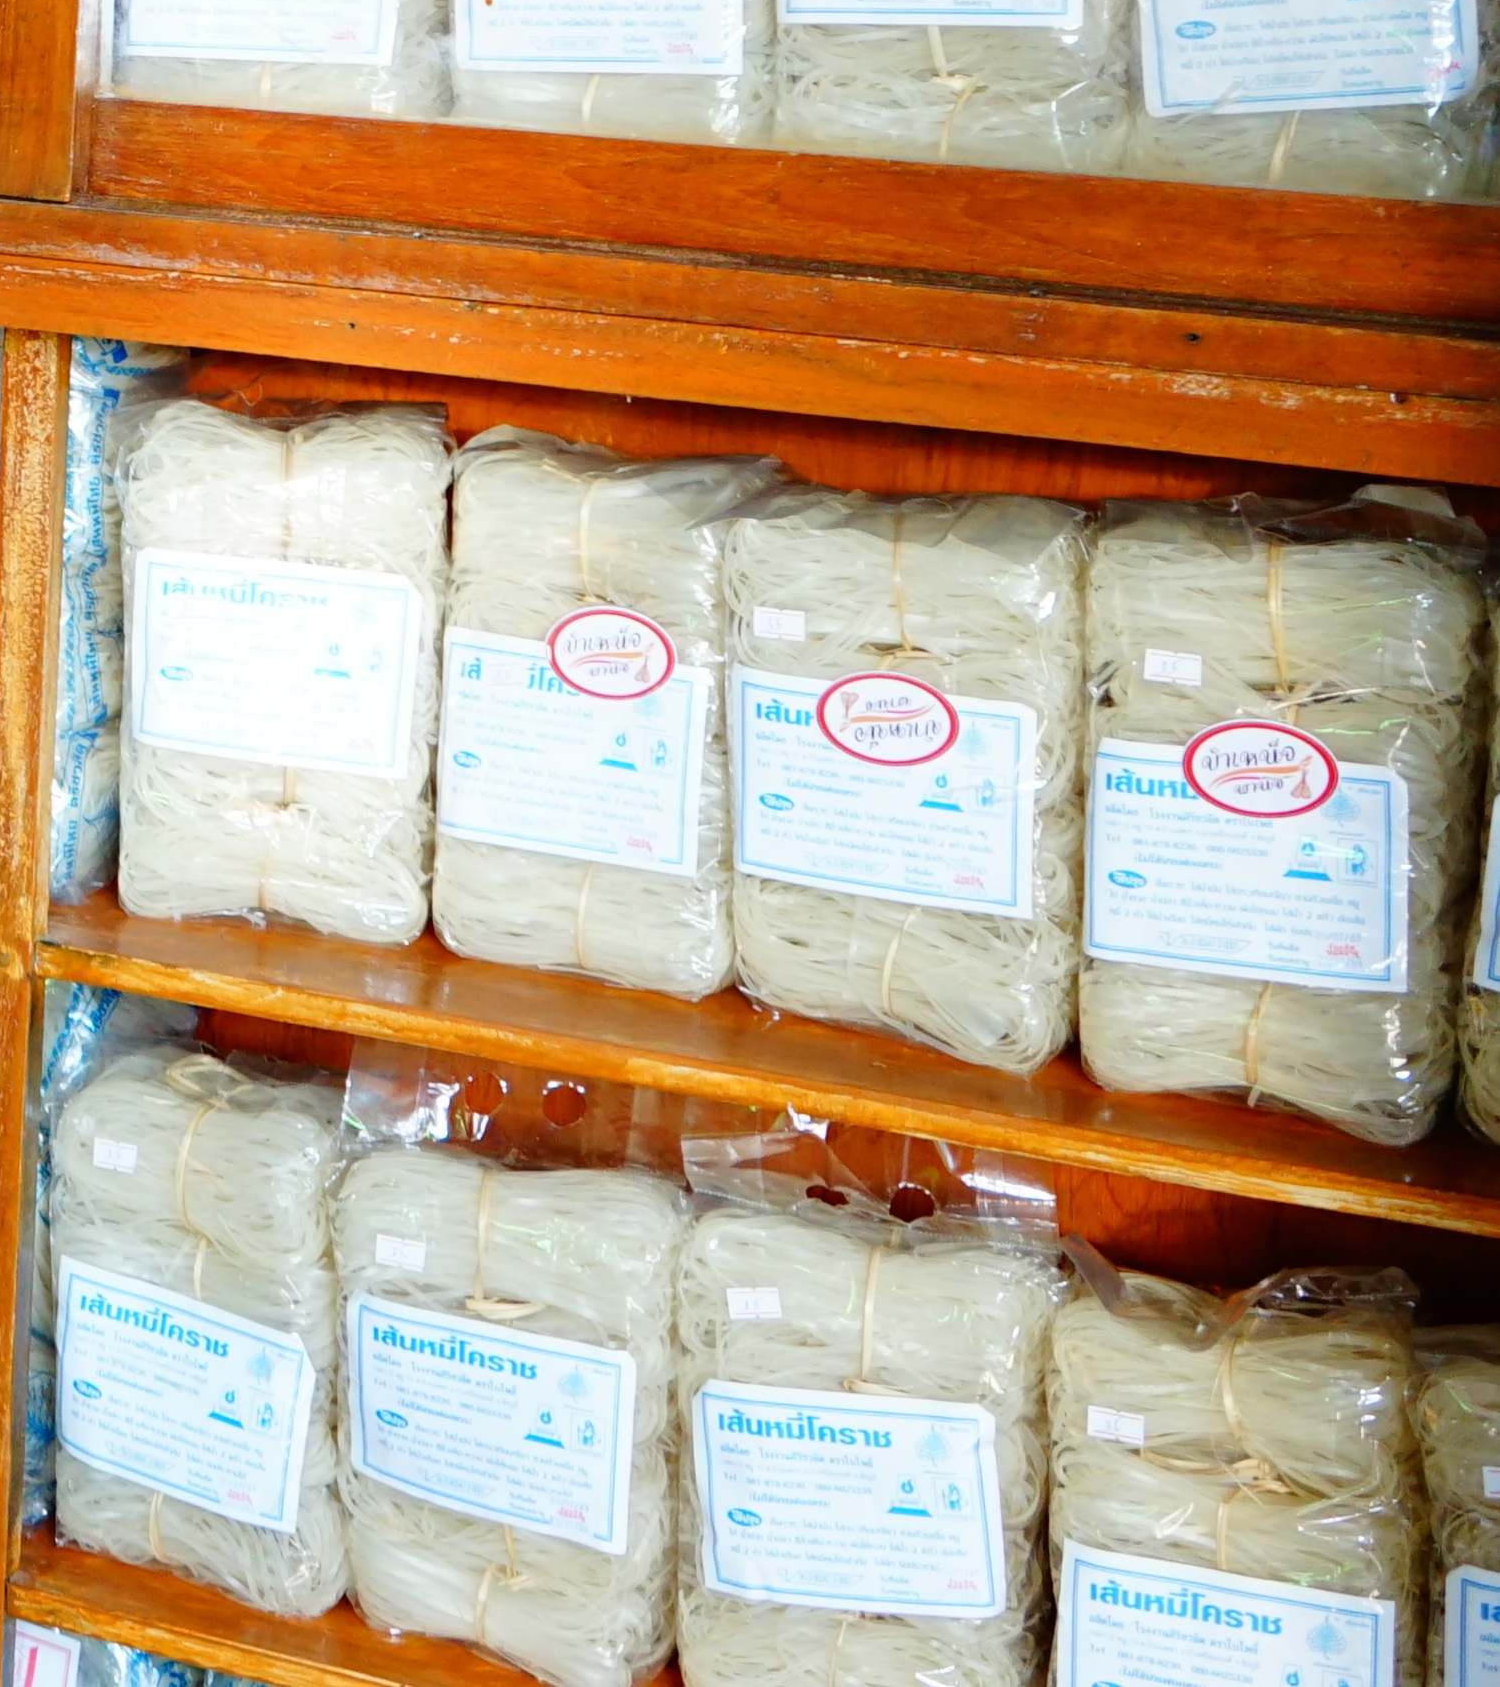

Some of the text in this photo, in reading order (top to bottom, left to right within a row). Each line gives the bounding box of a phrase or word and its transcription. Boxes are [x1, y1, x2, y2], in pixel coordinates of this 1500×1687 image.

[79, 1293, 230, 1359] เส้นหมี่โคราช
[372, 1325, 538, 1380] เส้นหมี่โคราช
[717, 1408, 893, 1449] เส้นหมี่โคราช
[1088, 1579, 1283, 1636] เส้นหมี่โคราช
